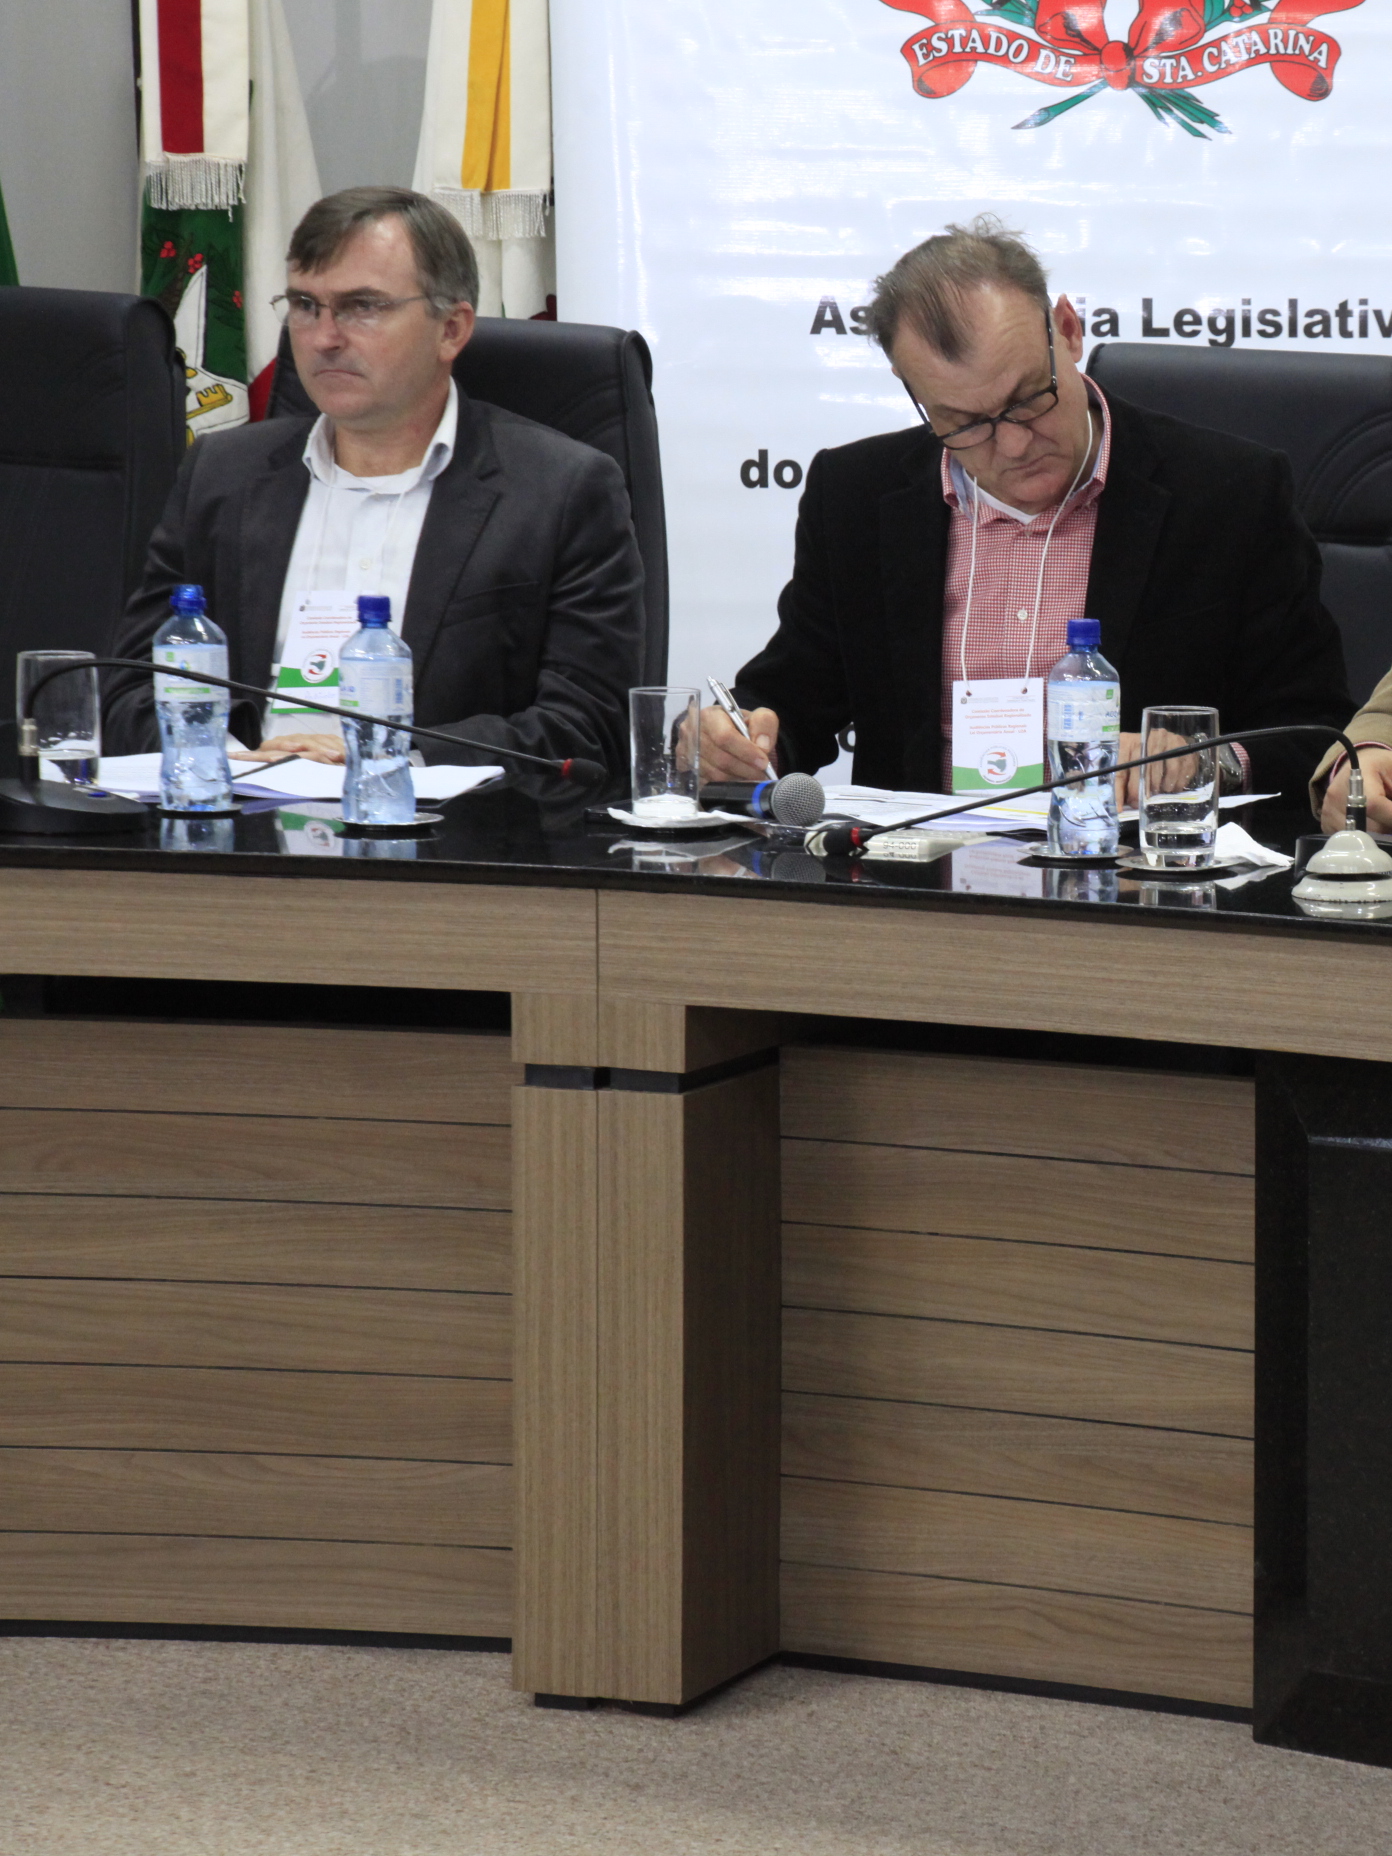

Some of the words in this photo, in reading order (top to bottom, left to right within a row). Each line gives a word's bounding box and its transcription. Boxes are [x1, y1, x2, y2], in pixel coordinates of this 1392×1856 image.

[914, 28, 1029, 66] ESTADO
[1033, 49, 1075, 82] DE
[1203, 30, 1330, 73] CATARINA
[740, 448, 803, 489] do
